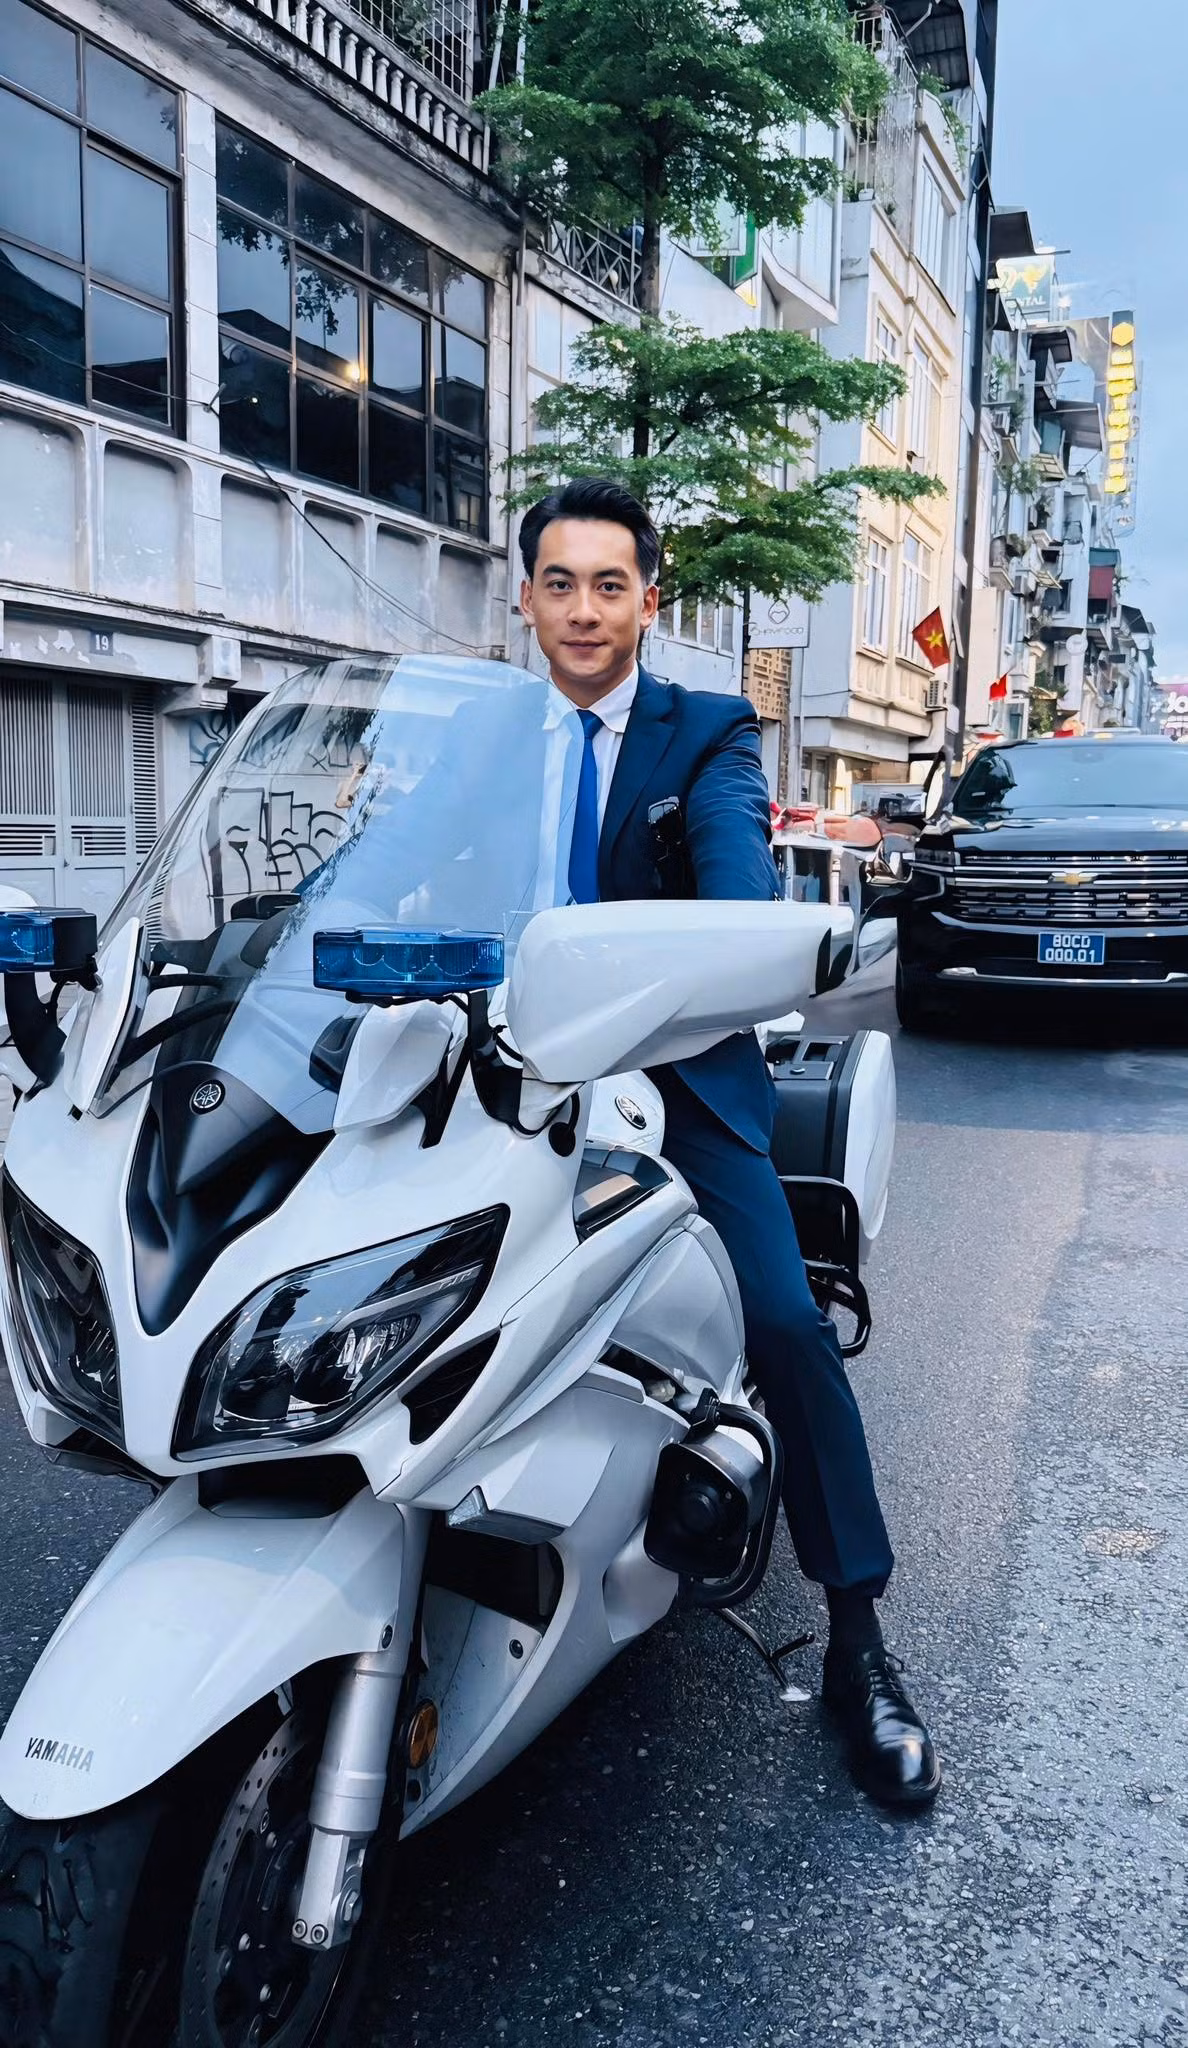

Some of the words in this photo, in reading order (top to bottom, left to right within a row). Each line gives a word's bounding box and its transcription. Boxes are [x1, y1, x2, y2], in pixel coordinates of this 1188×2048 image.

[95, 634, 109, 651] 19
[1045, 947, 1096, 963] 000.01
[25, 1737, 94, 1772] YAMAHA
